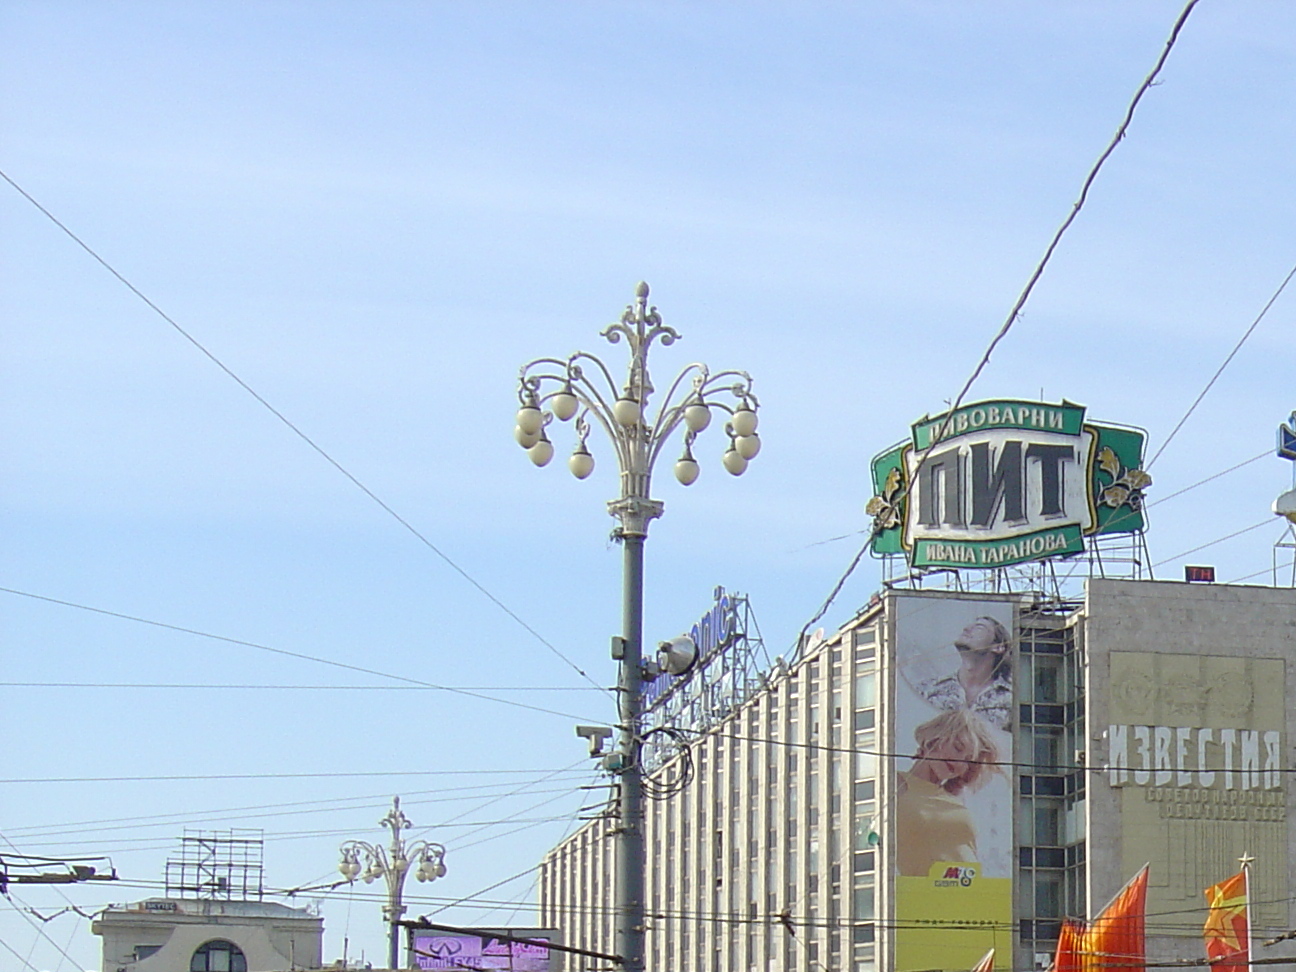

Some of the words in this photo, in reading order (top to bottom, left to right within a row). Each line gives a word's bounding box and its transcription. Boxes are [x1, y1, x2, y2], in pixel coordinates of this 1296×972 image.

[928, 403, 1065, 442] ПИВОВАРНИ
[916, 440, 1077, 531] ПИТ
[925, 543, 977, 564] ИВАНА
[979, 531, 1068, 564] ТАРАНОВА
[1109, 724, 1281, 790] ИЗВЕСТИЯ
